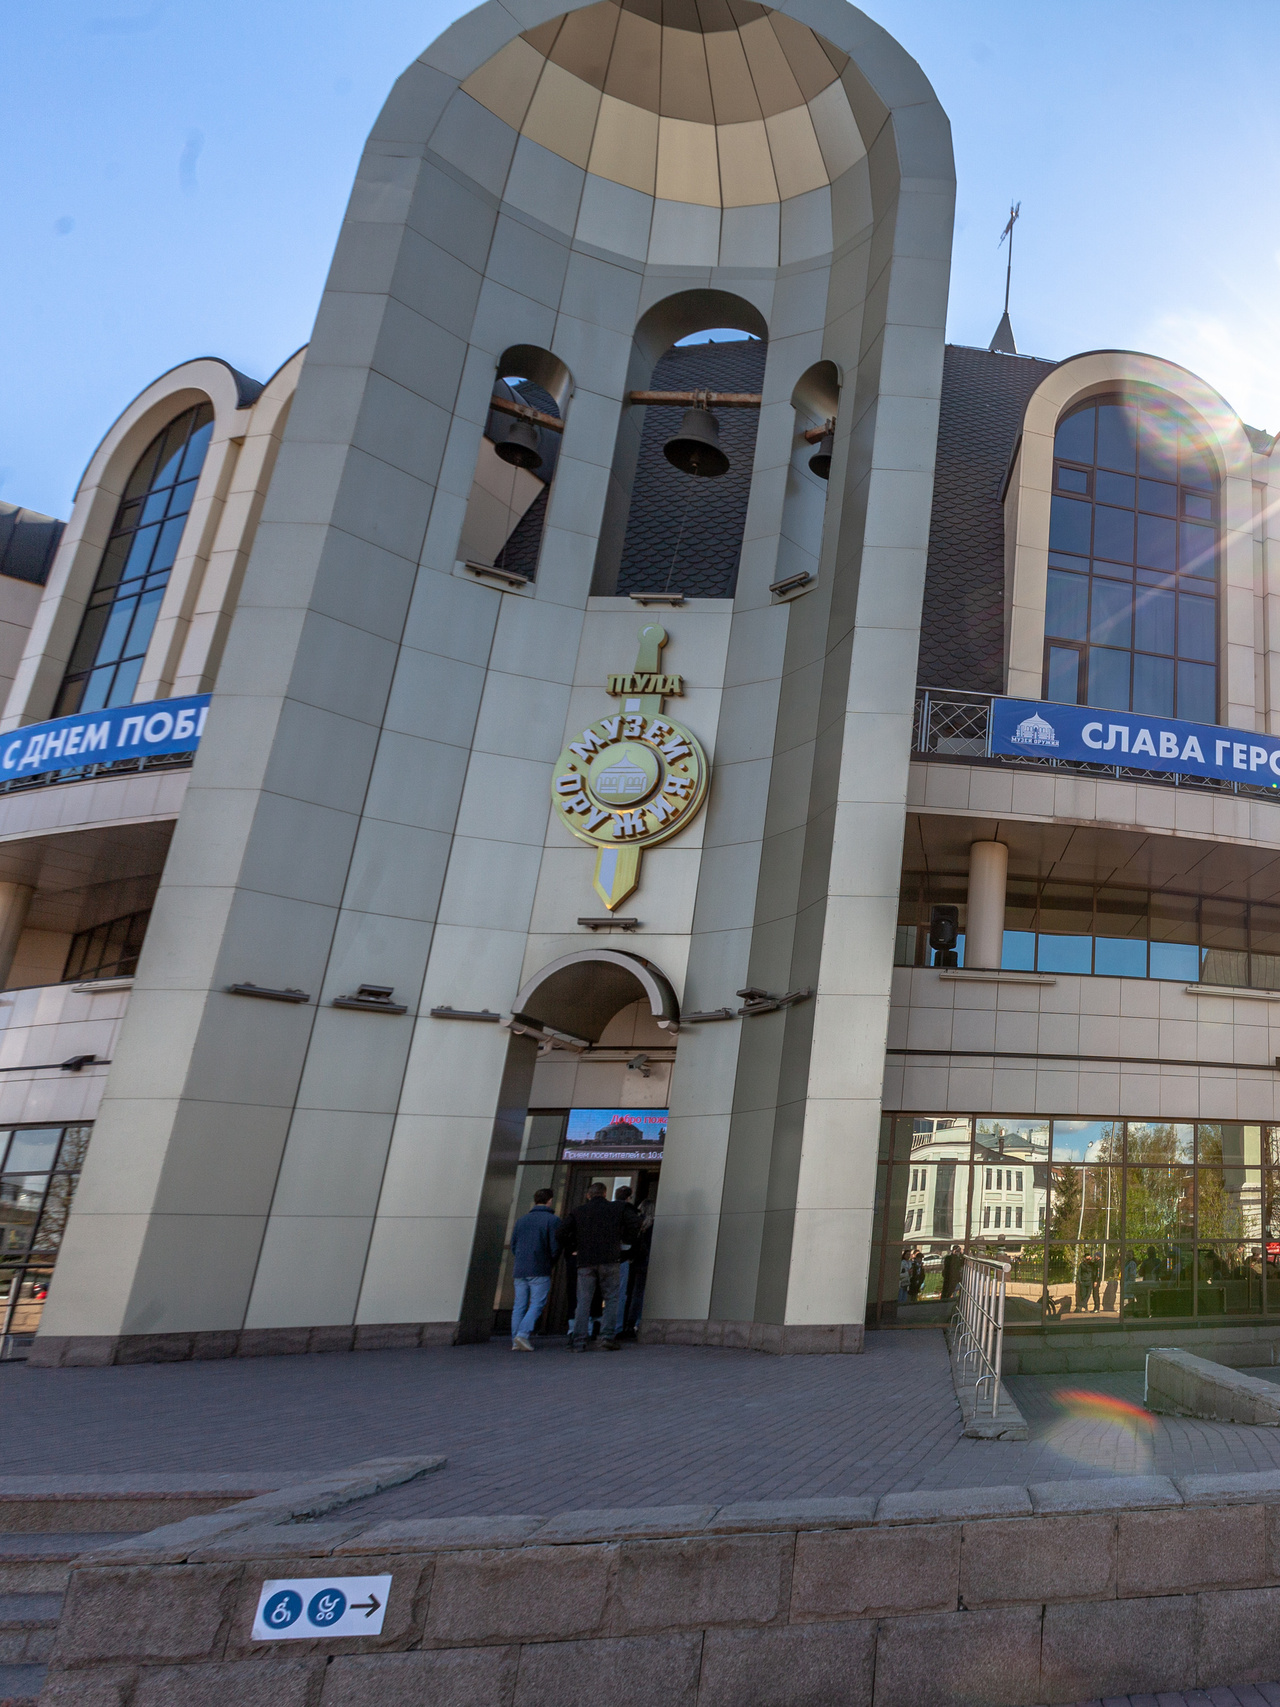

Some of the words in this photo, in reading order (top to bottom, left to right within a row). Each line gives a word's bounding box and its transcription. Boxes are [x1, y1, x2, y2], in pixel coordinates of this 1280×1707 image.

[606, 673, 684, 695] ТУЛА
[3, 740, 22, 769] С
[17, 721, 110, 770] ДНЕМ
[1082, 721, 1205, 764] СЛАВА
[555, 773, 695, 839] ОРУЖИЯ
[610, 1114, 642, 1125] Добро
[591, 1150, 640, 1159] посетителей
